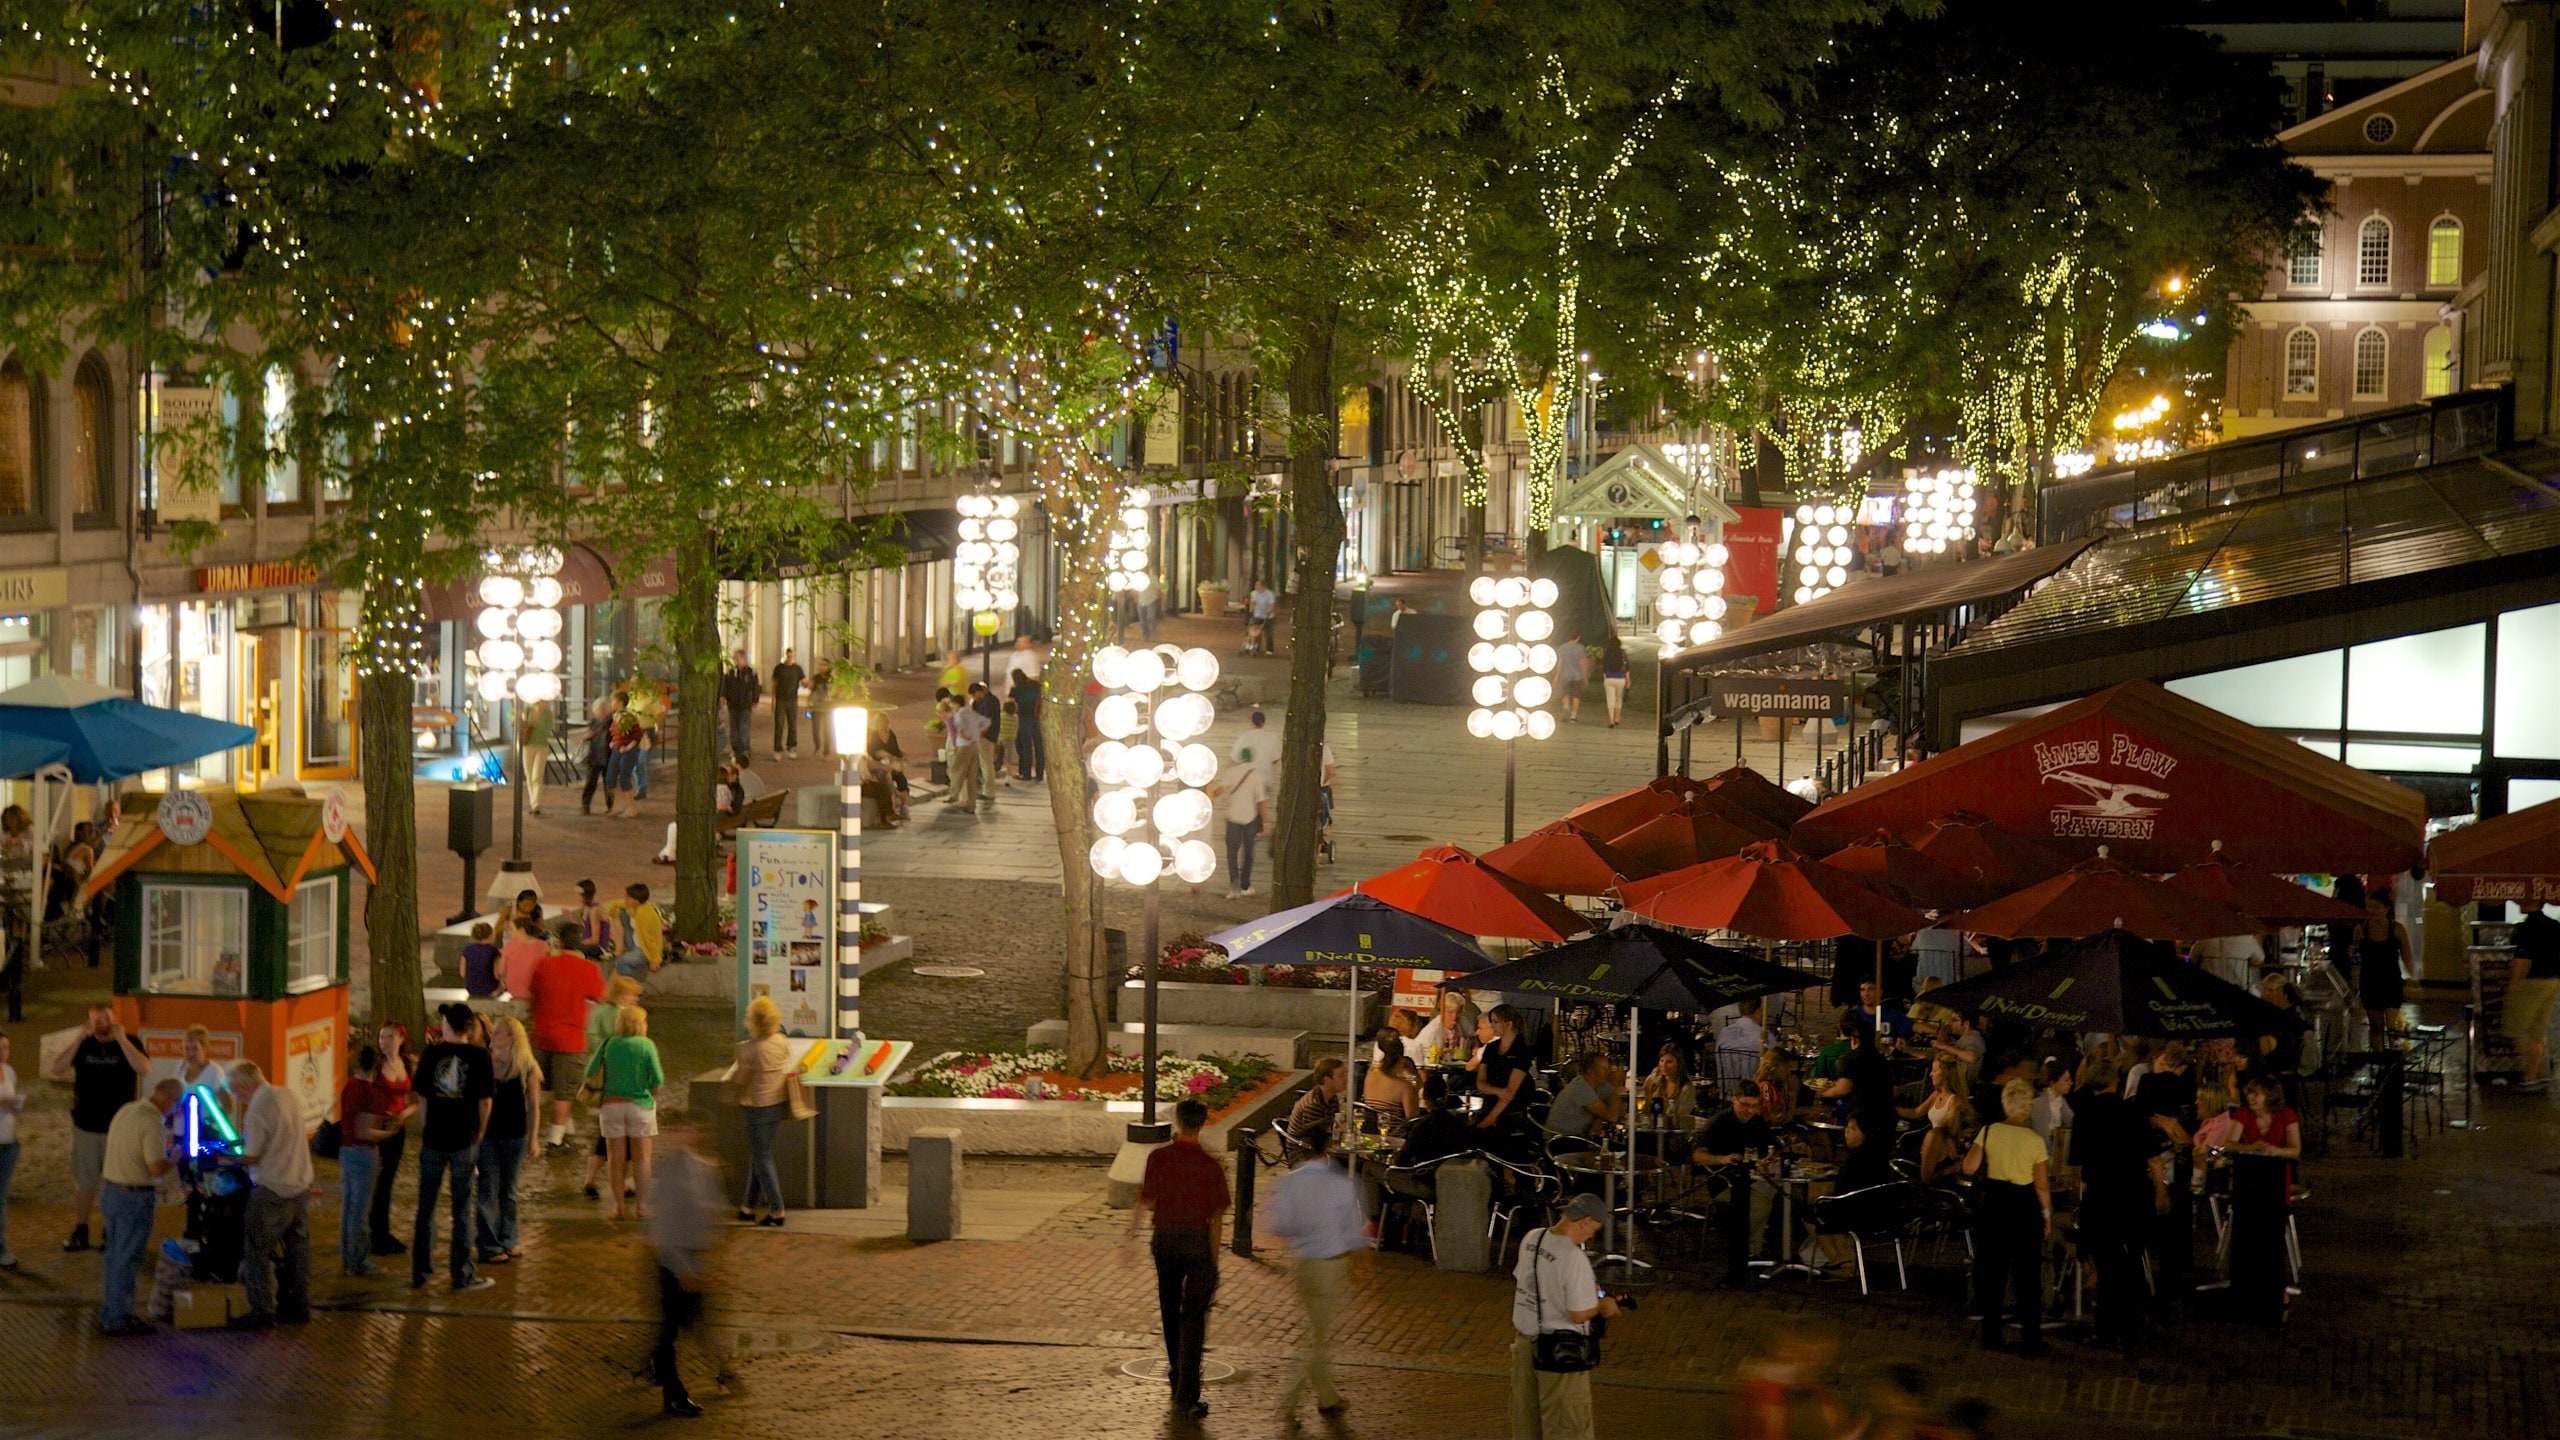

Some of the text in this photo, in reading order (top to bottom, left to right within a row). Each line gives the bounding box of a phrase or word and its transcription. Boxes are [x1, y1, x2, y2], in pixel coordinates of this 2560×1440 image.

[163, 400, 212, 409] SOUTH
[207, 563, 249, 592] URBAN
[0, 576, 37, 602] INS
[1723, 693, 1831, 713] wagamama
[2033, 733, 2178, 780] AMES PLOW
[2050, 809, 2155, 840] TAVERN
[760, 852, 781, 865] Fun
[751, 865, 824, 888] BOSTON
[1313, 951, 1353, 962] Ned
[1356, 953, 1432, 965] Devine's
[1529, 980, 1572, 992] Ned
[1405, 996, 1437, 1007] MEN
